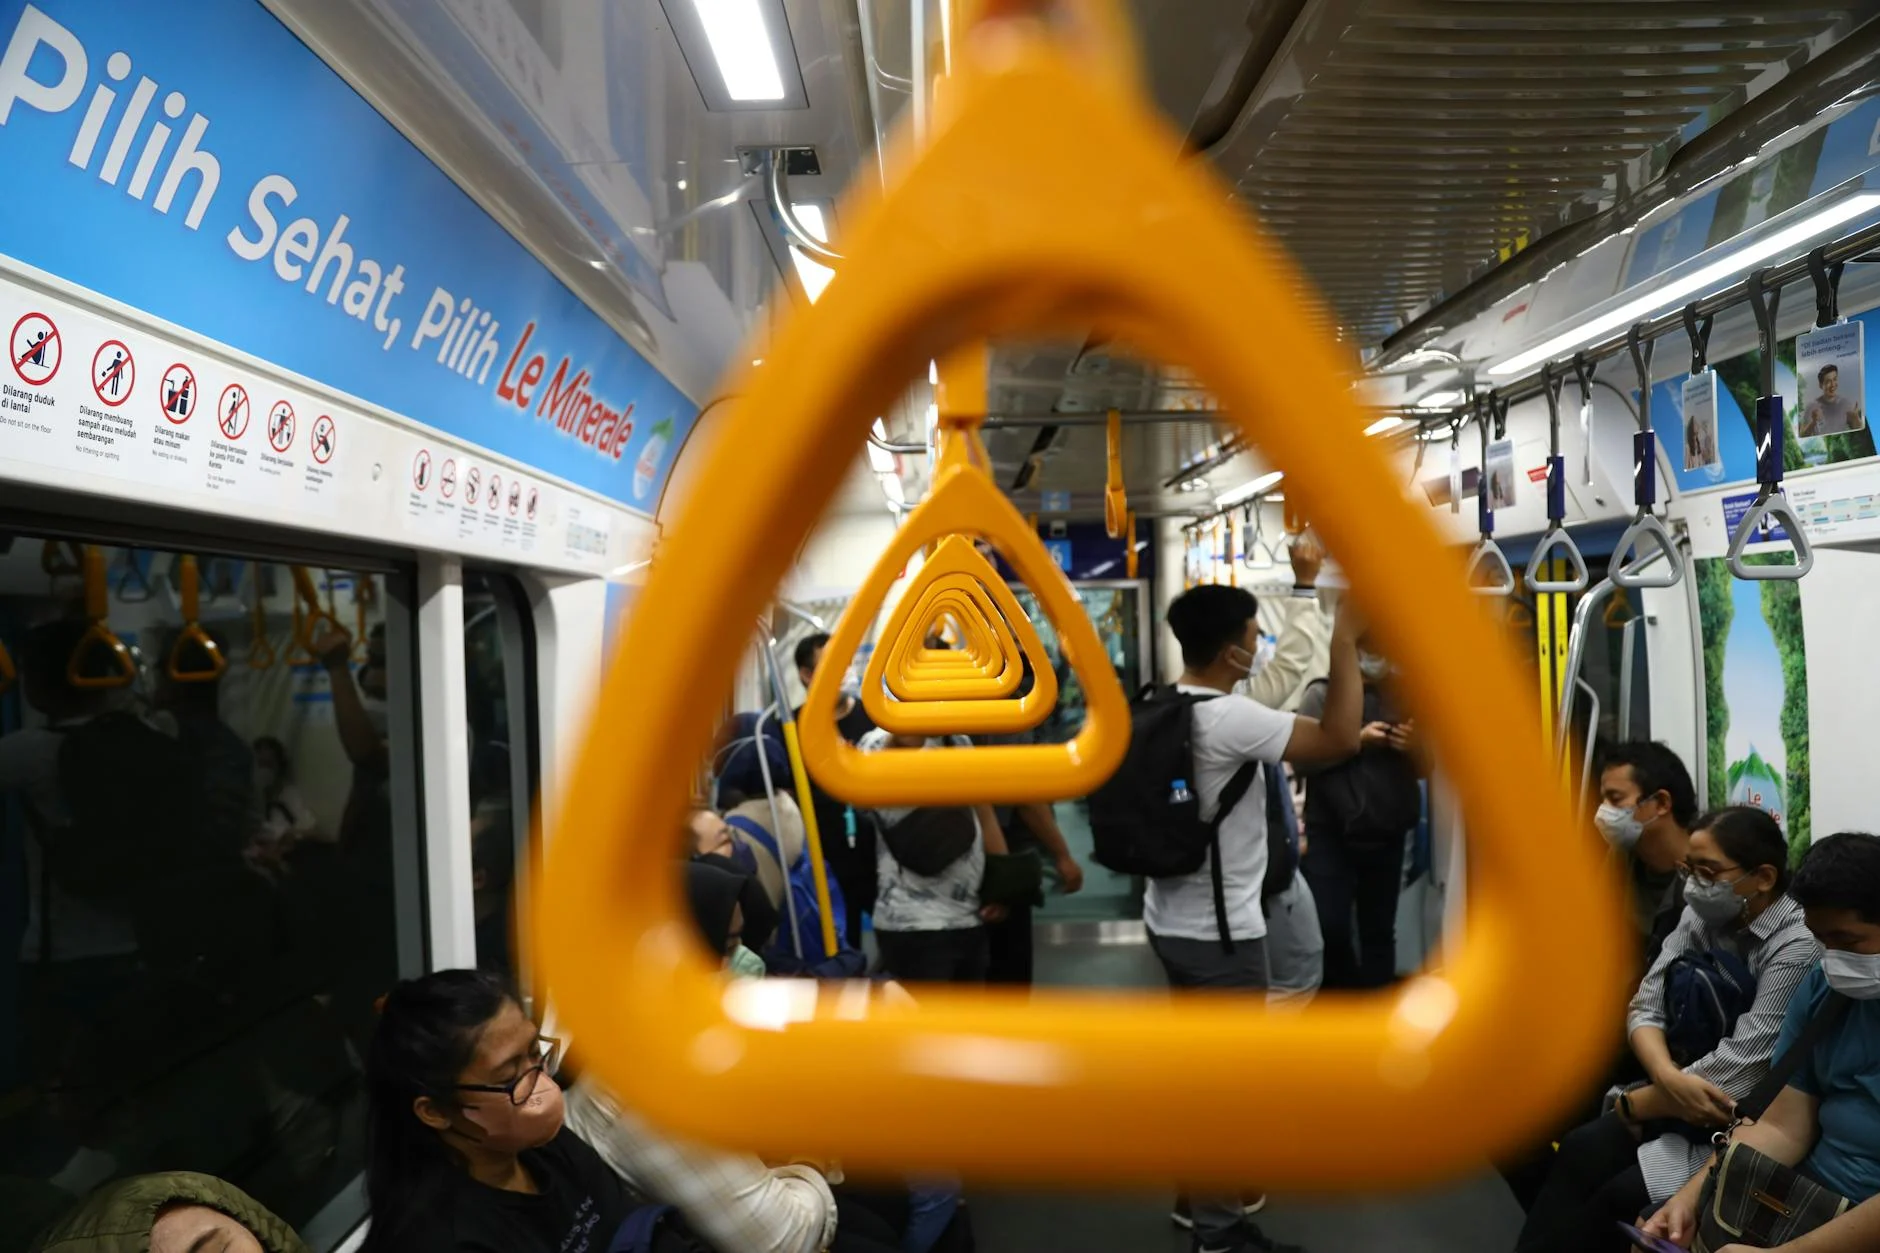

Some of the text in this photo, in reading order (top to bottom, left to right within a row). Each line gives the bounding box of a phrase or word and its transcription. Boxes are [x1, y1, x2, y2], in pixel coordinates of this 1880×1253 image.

[0, 2, 635, 461] Pilih Sehat, Pilih Le Minerale
[3, 384, 55, 406] Dilarang duduk
[1, 397, 31, 414] di lantai
[79, 405, 133, 428] Dilarang membuang
[8, 418, 17, 427] not
[32, 424, 40, 432] the
[41, 425, 52, 434] floor
[78, 418, 137, 439] sampah atau meludah
[154, 424, 175, 439] Dilarang
[77, 429, 115, 446] sembarangan
[153, 436, 164, 446] atau
[1747, 787, 1761, 806] Le
